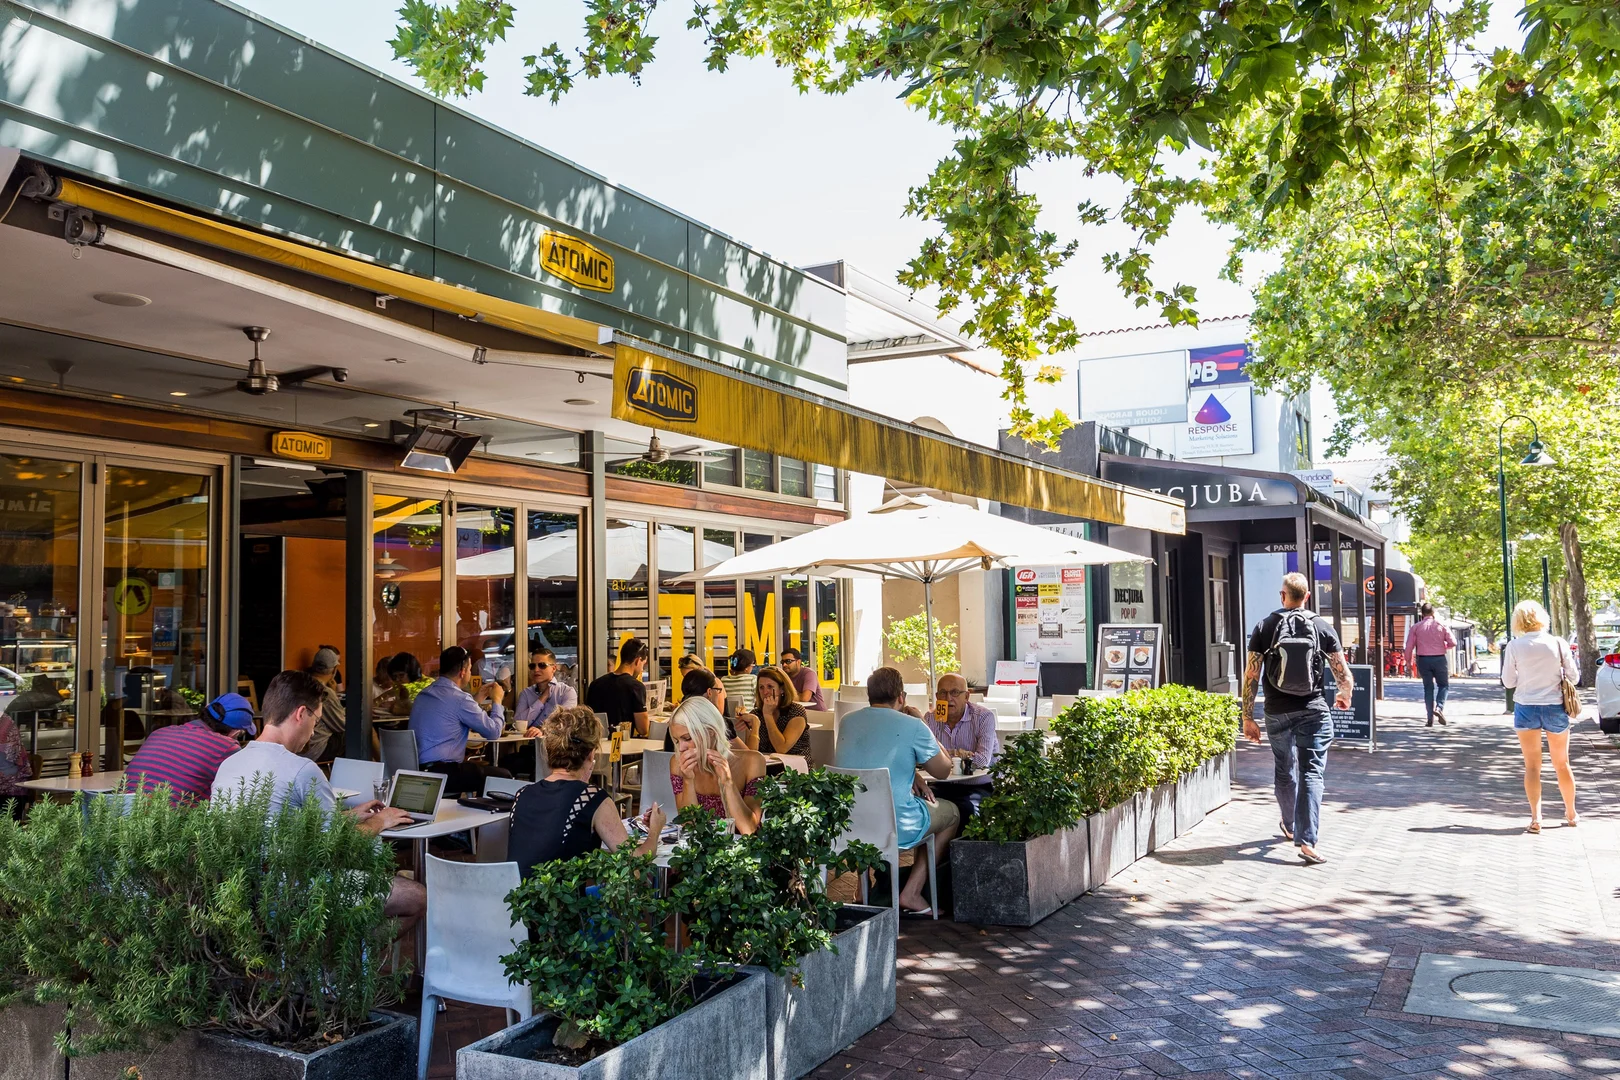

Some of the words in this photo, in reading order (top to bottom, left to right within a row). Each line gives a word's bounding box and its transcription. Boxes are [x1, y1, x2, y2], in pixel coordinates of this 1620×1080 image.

[547, 241, 609, 283] ATOMIC
[1190, 361, 1219, 384] AB
[632, 377, 693, 415] ATOMIC
[1188, 424, 1238, 435] RESPONSE
[279, 437, 324, 455] ATOMIC
[1150, 482, 1267, 507] CJUBA
[1313, 542, 1326, 550] AT
[1019, 571, 1034, 580] IGA
[1114, 588, 1144, 605] DECJUBA
[1120, 607, 1130, 619] POP
[1130, 607, 1137, 619] UP
[472, 678, 481, 688] 67
[936, 703, 946, 716] 95
[612, 736, 621, 753] 74
